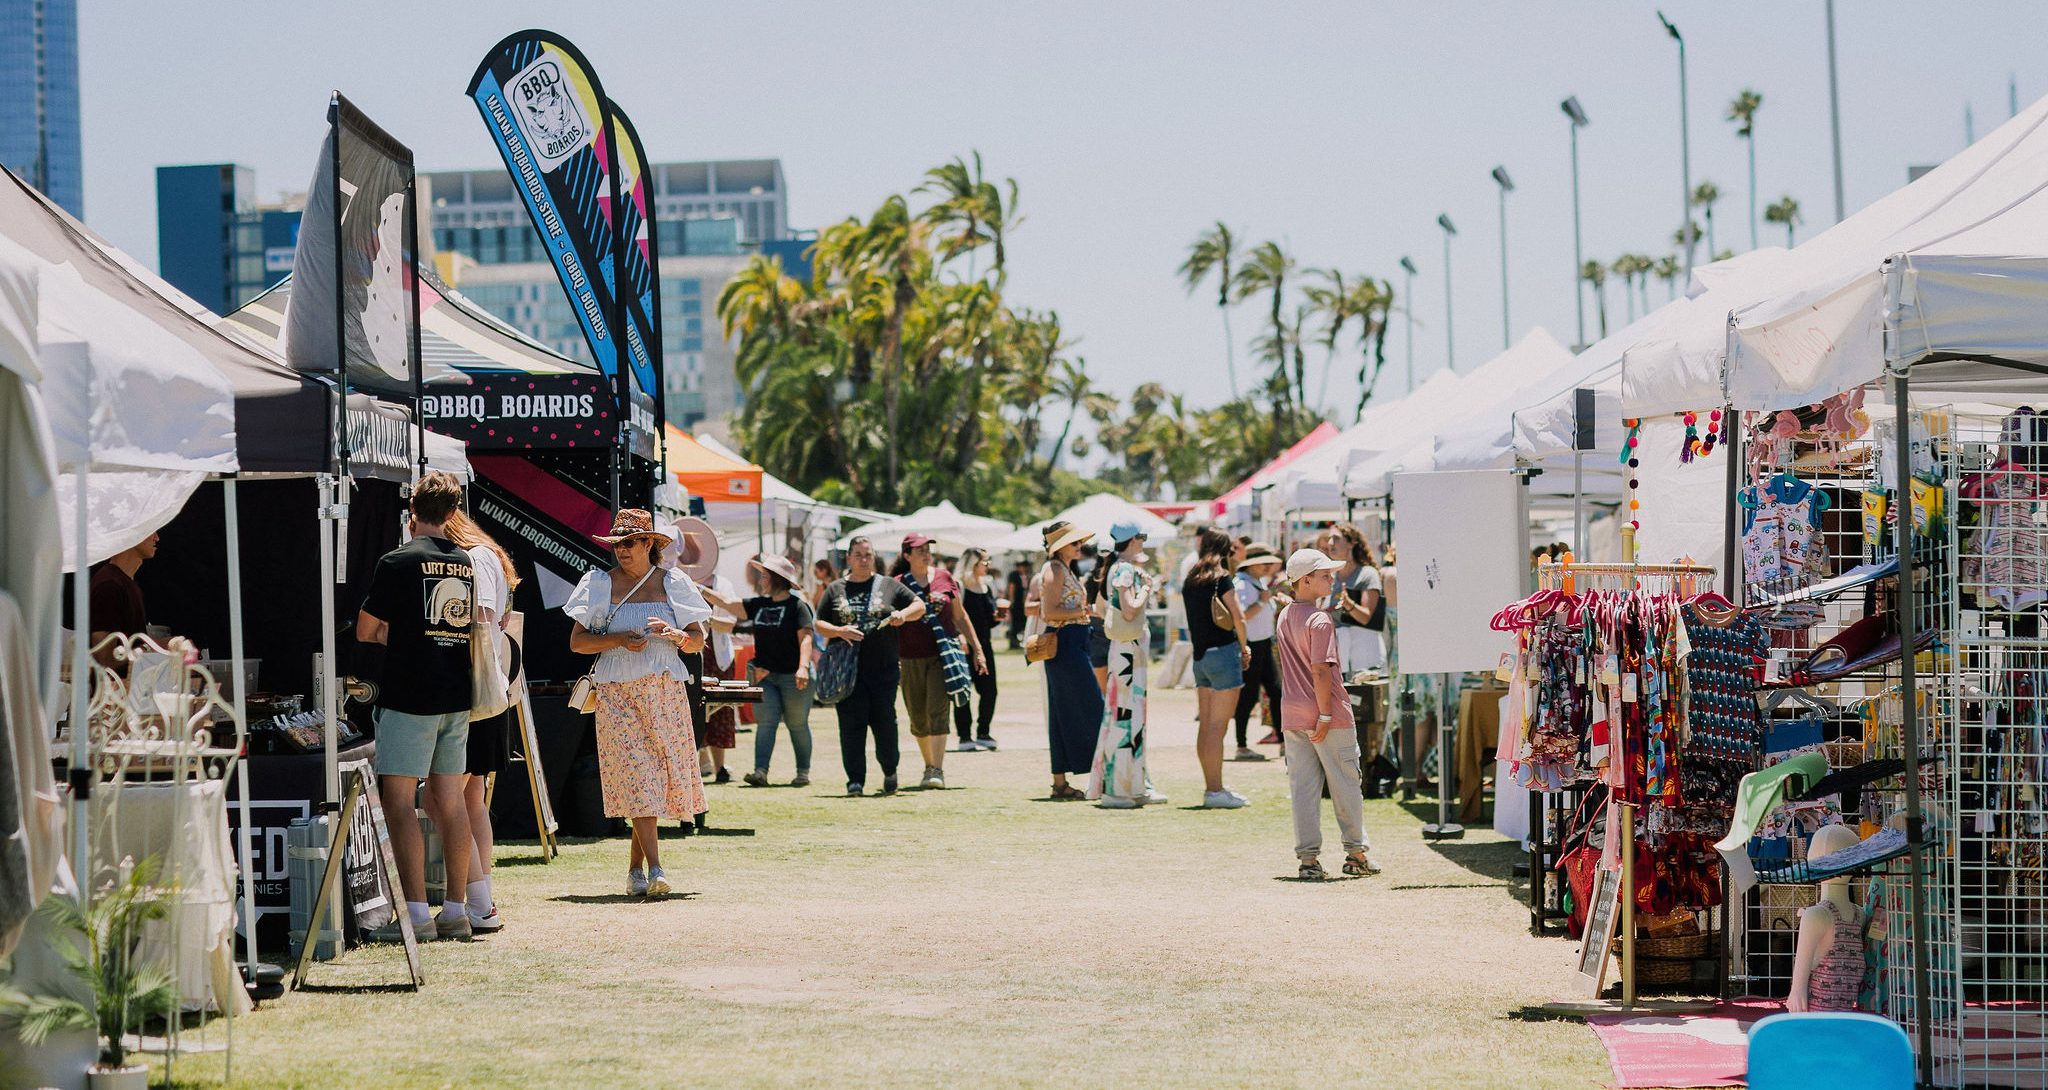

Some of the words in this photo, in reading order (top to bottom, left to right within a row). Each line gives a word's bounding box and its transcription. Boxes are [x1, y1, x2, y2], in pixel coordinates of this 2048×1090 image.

[520, 69, 556, 101] BBQ
[547, 126, 580, 155] BOARDS
[486, 93, 563, 239] WWW.BBQBOARDS.STORE
[562, 252, 606, 340] @BBQ_BOARDS
[417, 395, 594, 422] @BBQ_BOARDS
